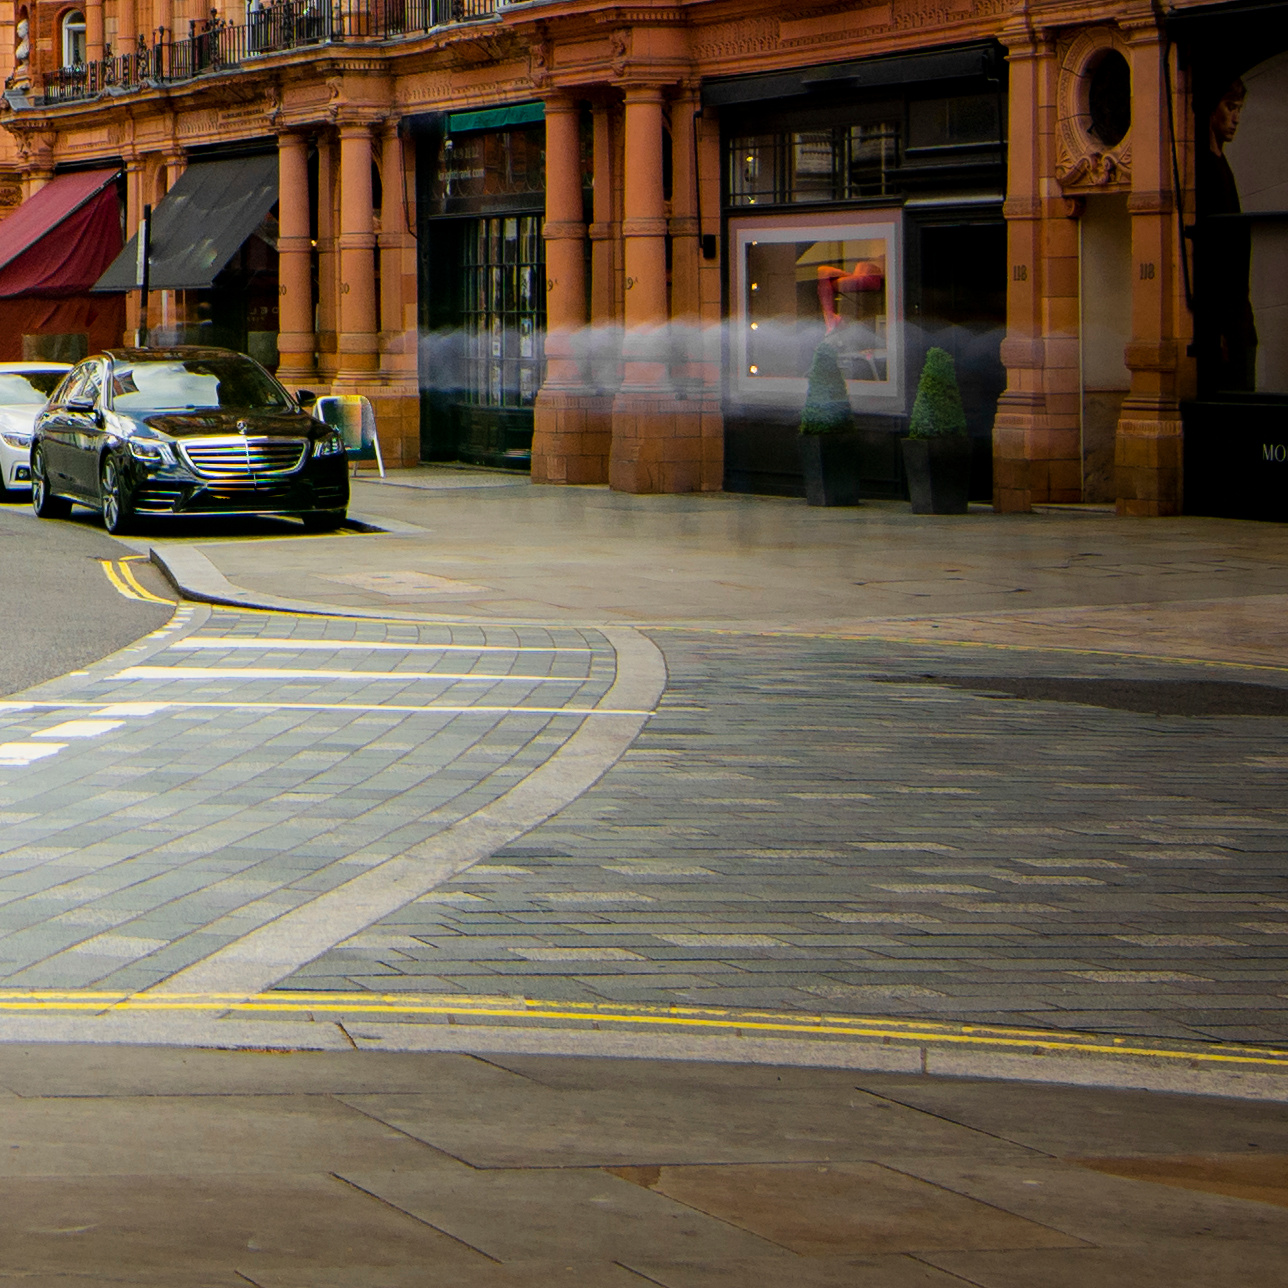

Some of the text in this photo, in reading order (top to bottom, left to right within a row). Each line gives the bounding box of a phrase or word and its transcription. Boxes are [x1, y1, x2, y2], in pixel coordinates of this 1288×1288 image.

[1013, 264, 1028, 281] 118
[1139, 262, 1155, 280] 118
[1262, 443, 1288, 463] MO
